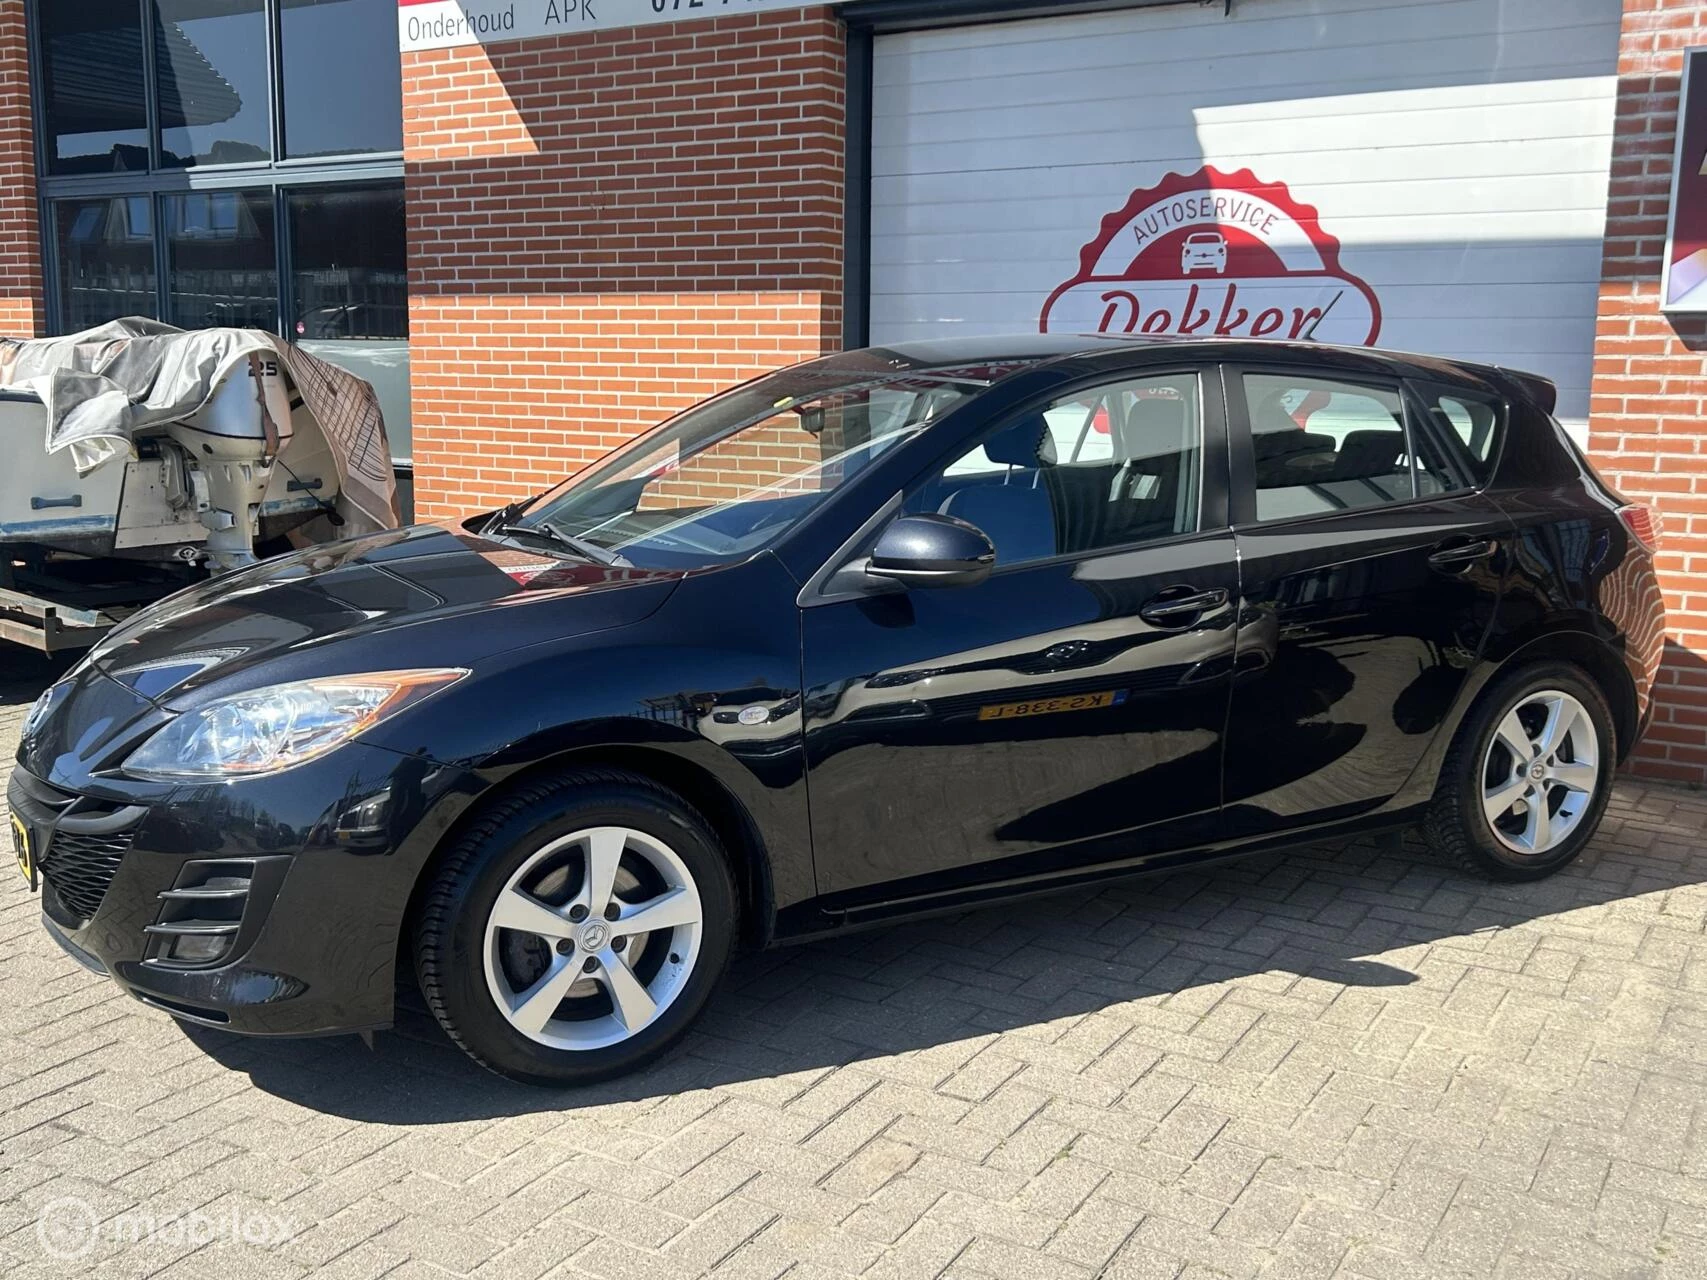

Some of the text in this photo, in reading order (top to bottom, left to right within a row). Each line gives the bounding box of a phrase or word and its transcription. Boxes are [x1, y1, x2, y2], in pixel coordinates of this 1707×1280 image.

[407, 0, 597, 42] Onderhoud APK
[1133, 196, 1279, 245] AUTOSERVICE
[1098, 283, 1322, 340] Dekker
